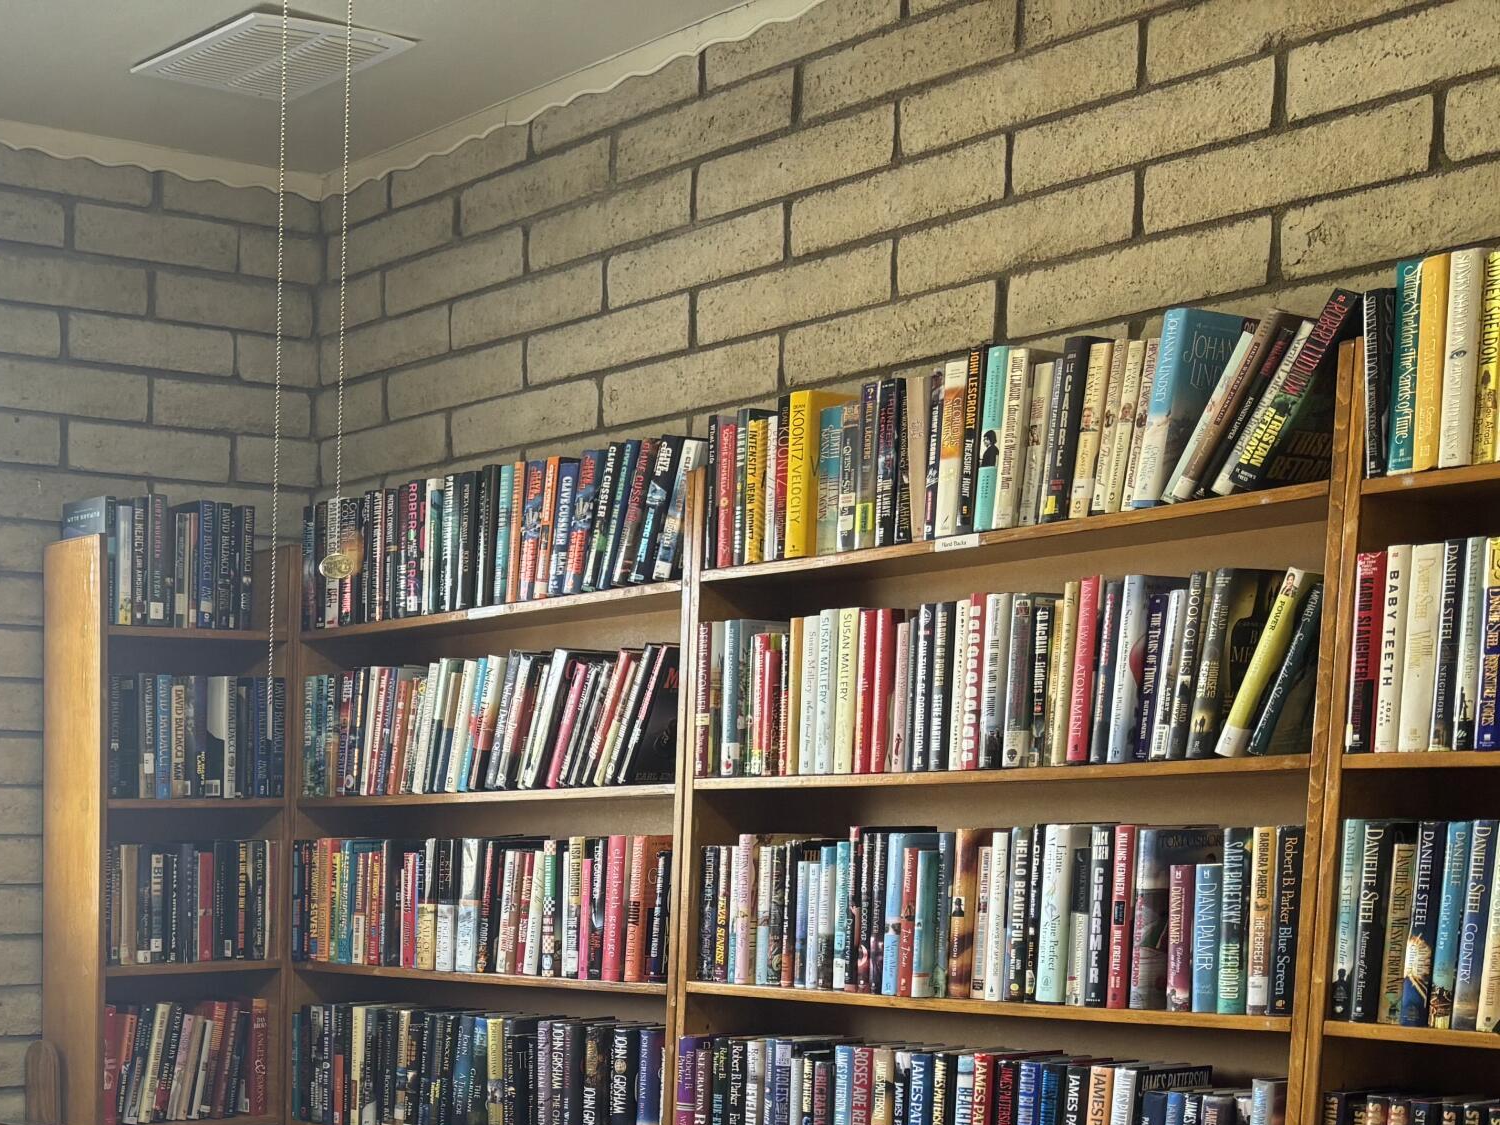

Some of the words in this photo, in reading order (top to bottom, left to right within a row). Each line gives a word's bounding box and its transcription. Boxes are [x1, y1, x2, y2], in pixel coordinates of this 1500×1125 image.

[1311, 302, 1347, 344] ROBERT
[1161, 317, 1179, 363] JOHANNA
[969, 352, 979, 375] JOHN
[1012, 357, 1024, 372] LOUIS
[1282, 343, 1324, 398] LUDLUM
[1155, 365, 1173, 403] LINDSEY
[1398, 368, 1416, 400] Sands
[965, 377, 979, 429] LESCROART
[1007, 404, 1020, 432] Education
[1395, 402, 1414, 414] of
[792, 410, 805, 461] KOONTZ
[1395, 412, 1412, 444] Time
[963, 439, 974, 475] TREASURE
[1002, 444, 1017, 475] Wandering
[790, 464, 801, 523] VELOCITY
[962, 478, 972, 497] HUNT
[1002, 478, 1014, 489] Man
[1444, 545, 1458, 603] DANIELLE
[1186, 589, 1199, 624] BOOK
[1359, 578, 1374, 611] KARIN
[1387, 570, 1399, 619] BABY
[842, 613, 852, 649] SUSAN
[1037, 611, 1048, 622] ED
[1150, 613, 1162, 627] THE
[1441, 608, 1454, 639] STEEL
[1036, 624, 1047, 654] McBAIN
[1148, 628, 1161, 653] TEARS
[1184, 628, 1195, 644] OF
[1356, 616, 1372, 677] SLAUGHTER
[1147, 655, 1158, 665] OF
[1180, 648, 1194, 673] LIES
[1383, 627, 1396, 686] TEETH
[839, 653, 850, 701] MALLERY
[1034, 662, 1046, 693] Fiddlers
[1143, 666, 1156, 694] THINGS
[1436, 666, 1447, 718] NEIGHBORS
[933, 694, 942, 716] STEVE
[1072, 664, 1085, 737] ATONEMENT
[932, 718, 941, 751] MARTINI
[1015, 840, 1028, 875] HELLO
[1117, 833, 1128, 860] KILLING
[1225, 841, 1244, 867] SARA
[1258, 832, 1269, 868] BARBARA
[1283, 838, 1298, 875] Robert
[1362, 829, 1383, 886] DANIELLE
[1418, 831, 1434, 889] DANIELLE
[1471, 827, 1491, 880] DANIELLE
[610, 849, 622, 909] elizabeth
[1115, 863, 1127, 896] KENNEDY
[1257, 870, 1267, 898] PARKER
[1282, 878, 1294, 887] B.
[716, 896, 726, 924] TEXAS
[1011, 881, 1025, 944] BEAUTIFUL
[1197, 883, 1218, 921] DIANA
[1222, 872, 1241, 924] PARETSKY
[1280, 891, 1294, 925] Parker
[1359, 890, 1379, 923] STEEL
[1414, 894, 1428, 927] STEEL
[1467, 883, 1486, 914] STEEL
[607, 915, 620, 958] george
[1049, 915, 1060, 937] Nine
[1089, 867, 1104, 984] CHARMER
[1113, 930, 1123, 943] BILL
[1256, 917, 1266, 930] THE
[1278, 927, 1292, 952] Blue
[715, 928, 725, 964] SUNRISE
[1048, 940, 1060, 970] Perfect
[1196, 925, 1215, 970] PALMER
[1253, 932, 1264, 963] PERFECT
[1360, 931, 1370, 958] Matters
[1460, 923, 1478, 984] COUNTRY
[1219, 944, 1240, 999] OVERBOARD
[1275, 955, 1289, 995] Screen
[1357, 981, 1365, 1001] Heart
[613, 1035, 628, 1059] JOHN
[731, 1045, 742, 1071] Robert
[875, 1060, 886, 1081] JAMES
[613, 1075, 626, 1114] GRISHAM
[729, 1082, 741, 1106] Parker
[874, 1081, 886, 1119] PATTERSON
[957, 1087, 972, 1119] BEACH
[1091, 1073, 1107, 1116] JAMES
[1116, 1077, 1132, 1102] JAMES
[1182, 1100, 1196, 1124] JAMES
